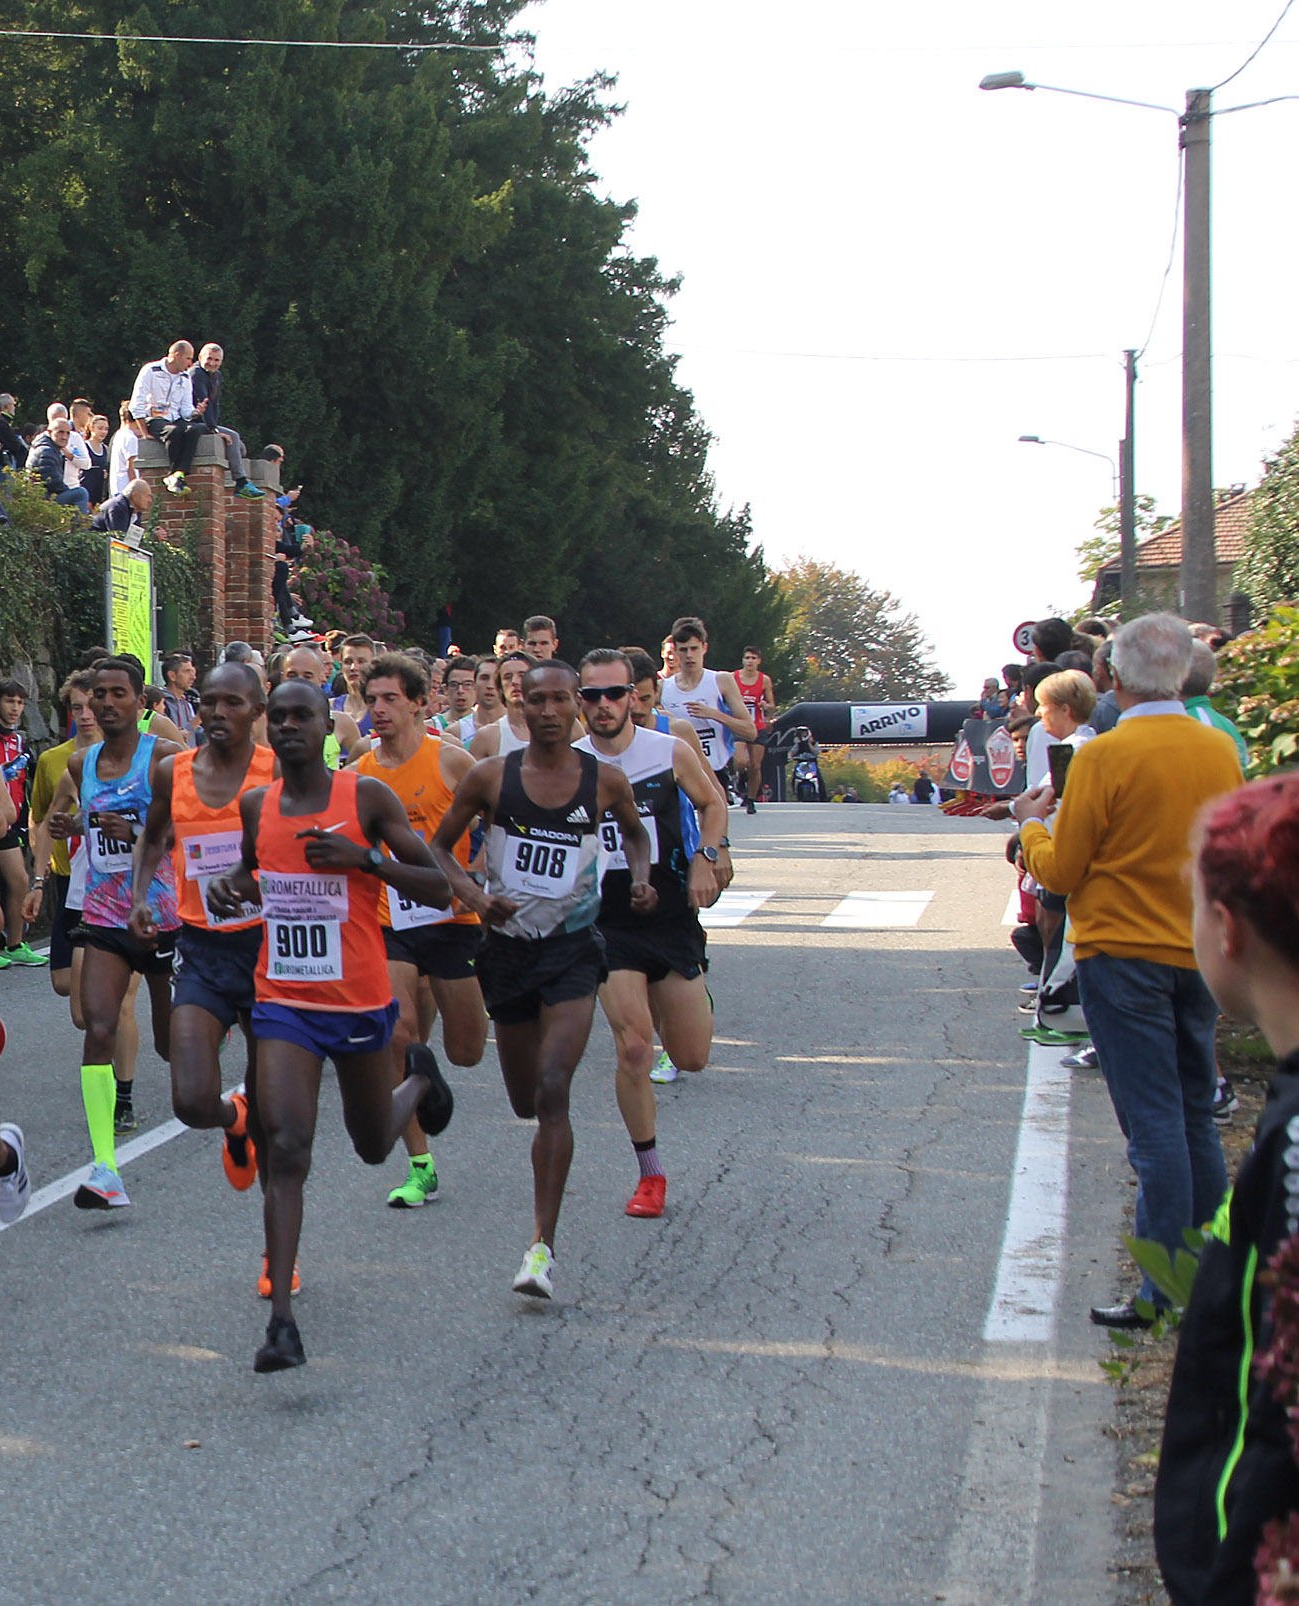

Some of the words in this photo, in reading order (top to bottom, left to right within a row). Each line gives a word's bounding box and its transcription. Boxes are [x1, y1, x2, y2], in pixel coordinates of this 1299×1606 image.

[859, 706, 921, 736] ARRIVO
[529, 827, 580, 843] DIADORA
[515, 841, 567, 879] 908
[276, 923, 328, 959] 900
